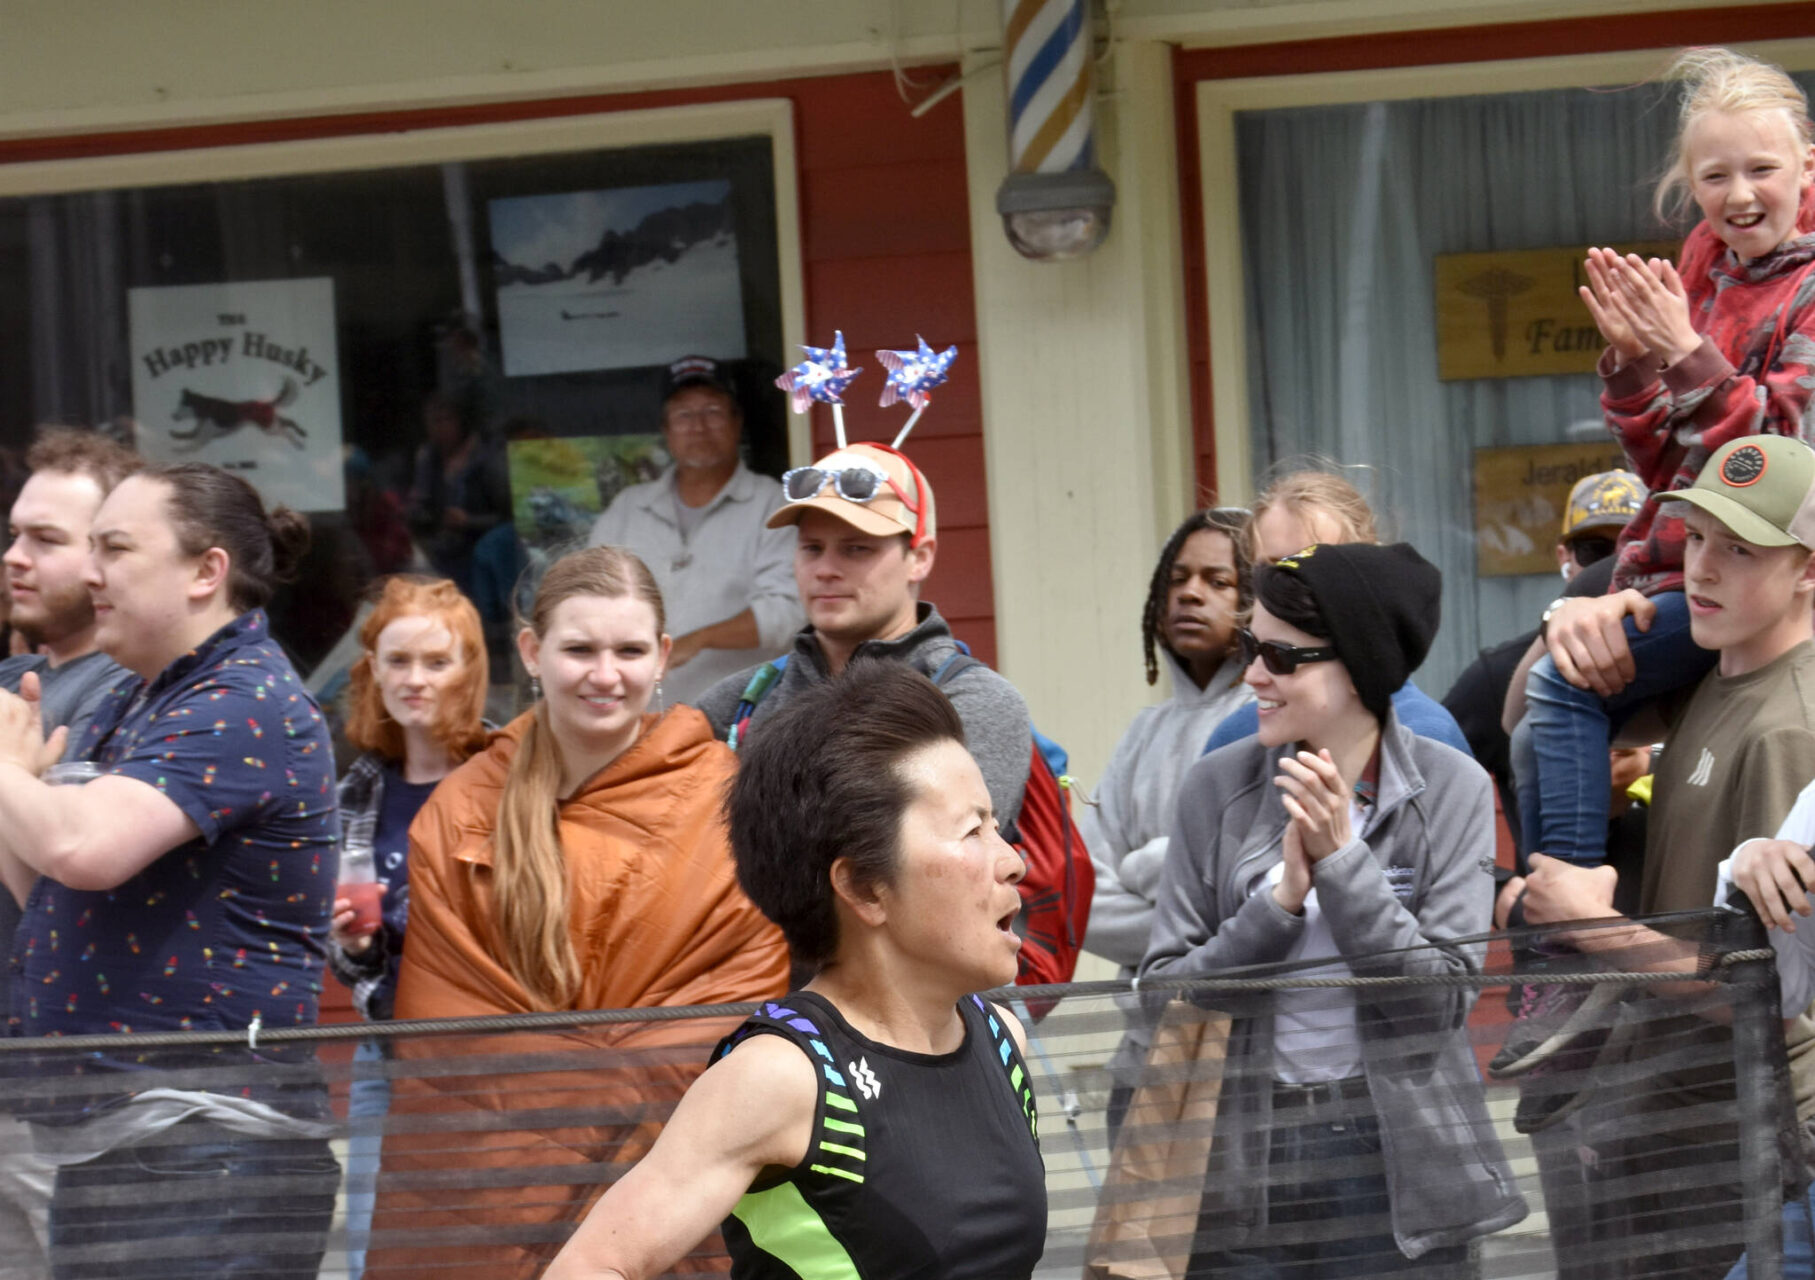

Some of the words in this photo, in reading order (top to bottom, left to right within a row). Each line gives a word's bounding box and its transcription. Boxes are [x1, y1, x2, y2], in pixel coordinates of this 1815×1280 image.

[1526, 318, 1602, 353] Fam
[143, 336, 234, 379] Happy
[242, 331, 328, 386] Husky
